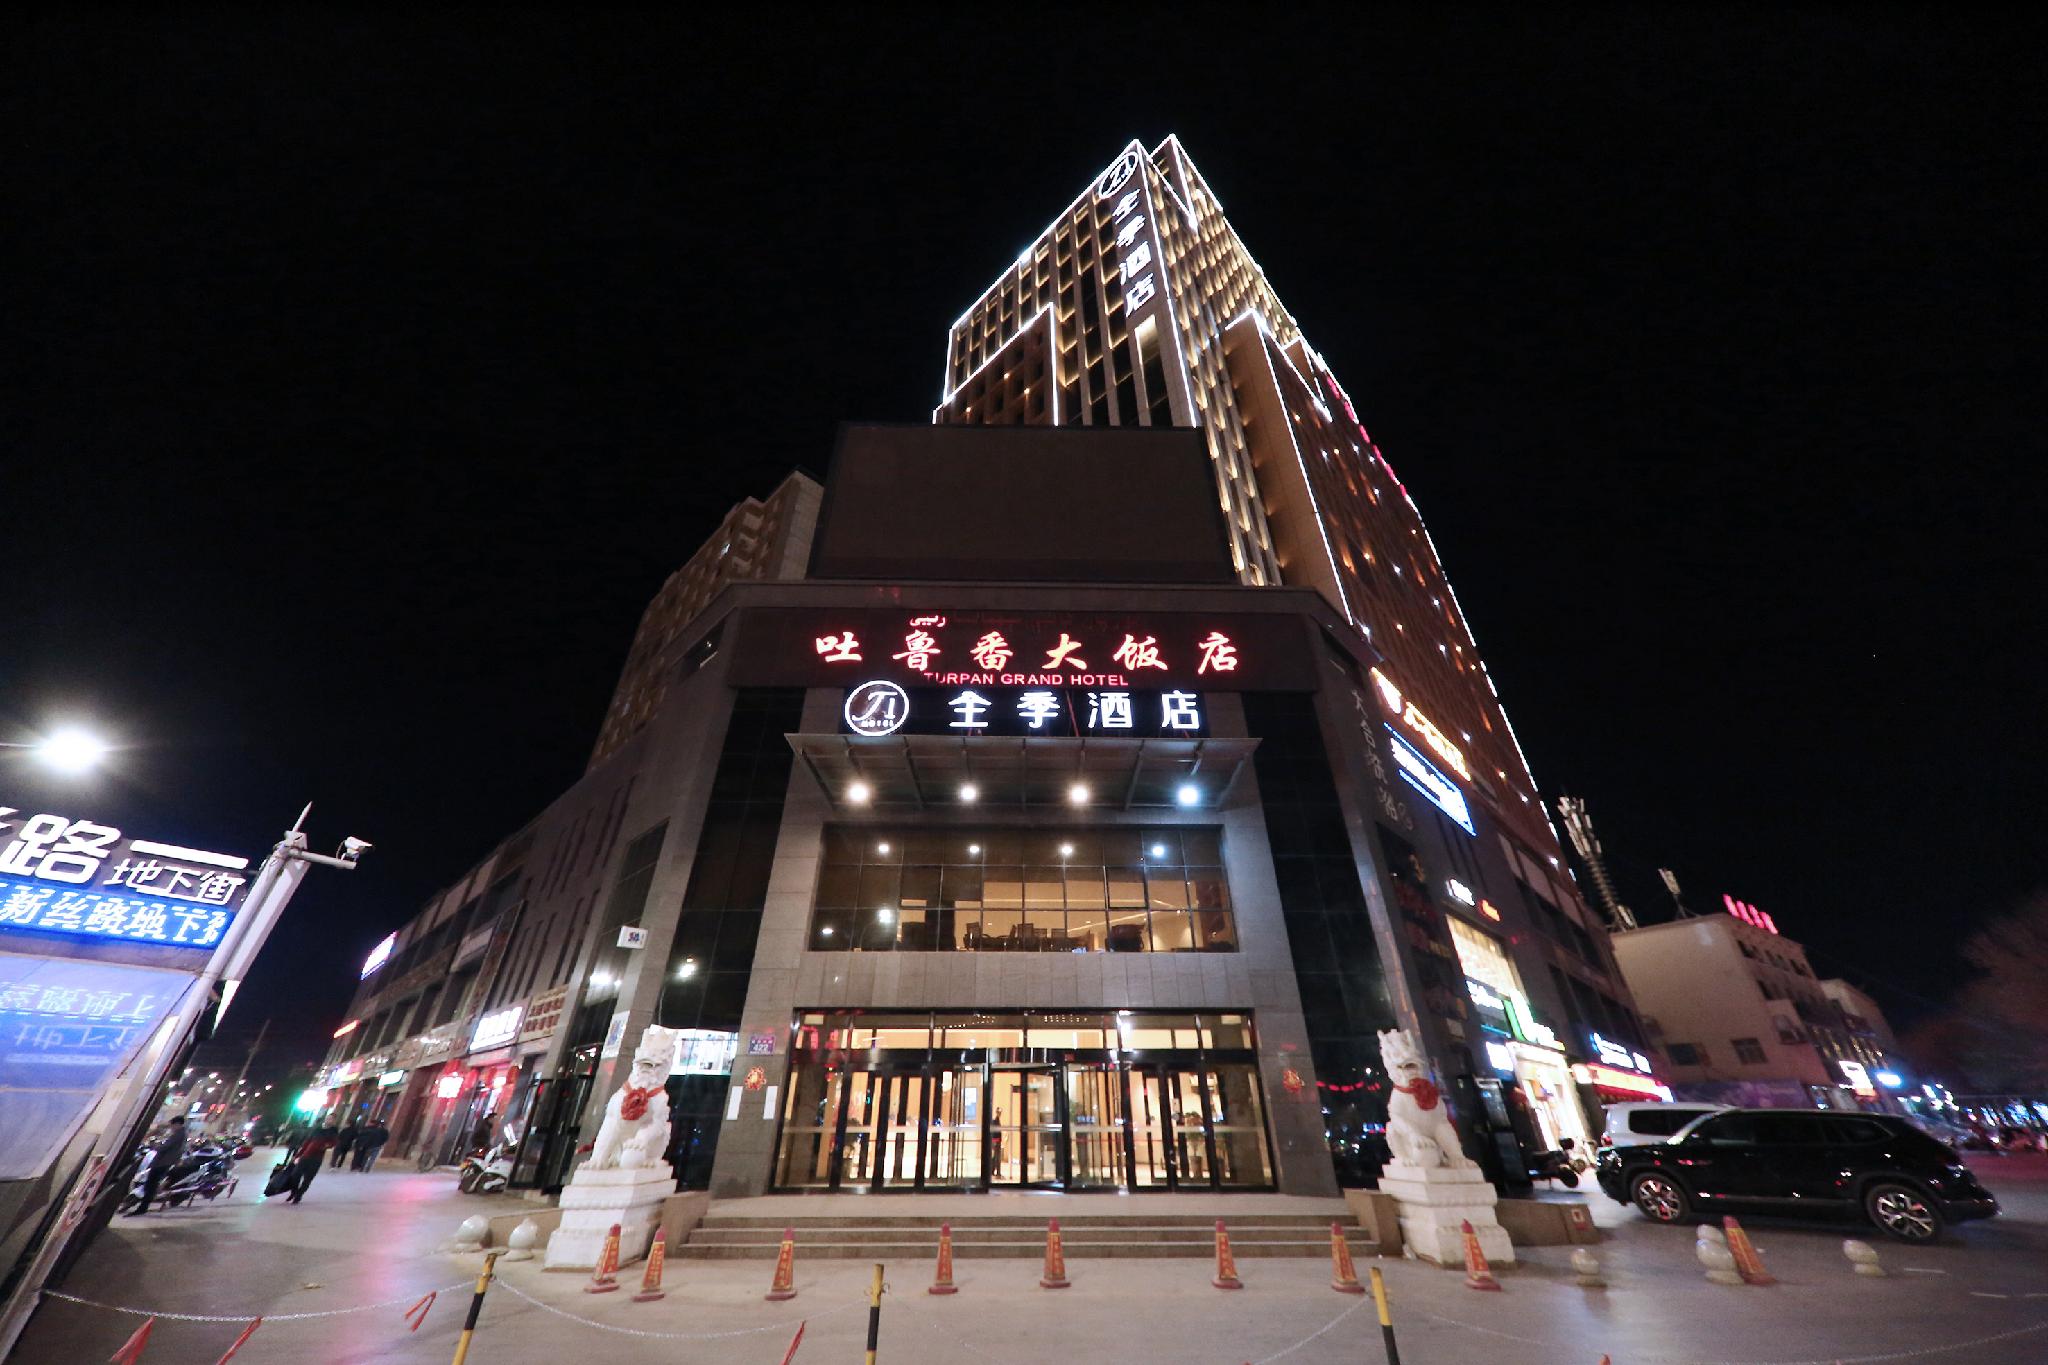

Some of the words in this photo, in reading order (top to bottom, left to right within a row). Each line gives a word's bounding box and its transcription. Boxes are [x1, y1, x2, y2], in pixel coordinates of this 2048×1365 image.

[1111, 188, 1156, 318] 全季酒店
[814, 631, 1240, 675] 吐鲁番大饭店
[923, 672, 993, 685] TURPAN
[1000, 673, 1063, 686] GRAND
[1071, 674, 1129, 687] HOTEL
[948, 689, 1203, 731] 全季酒店
[0, 806, 121, 885] 路
[103, 858, 246, 906] 地下街
